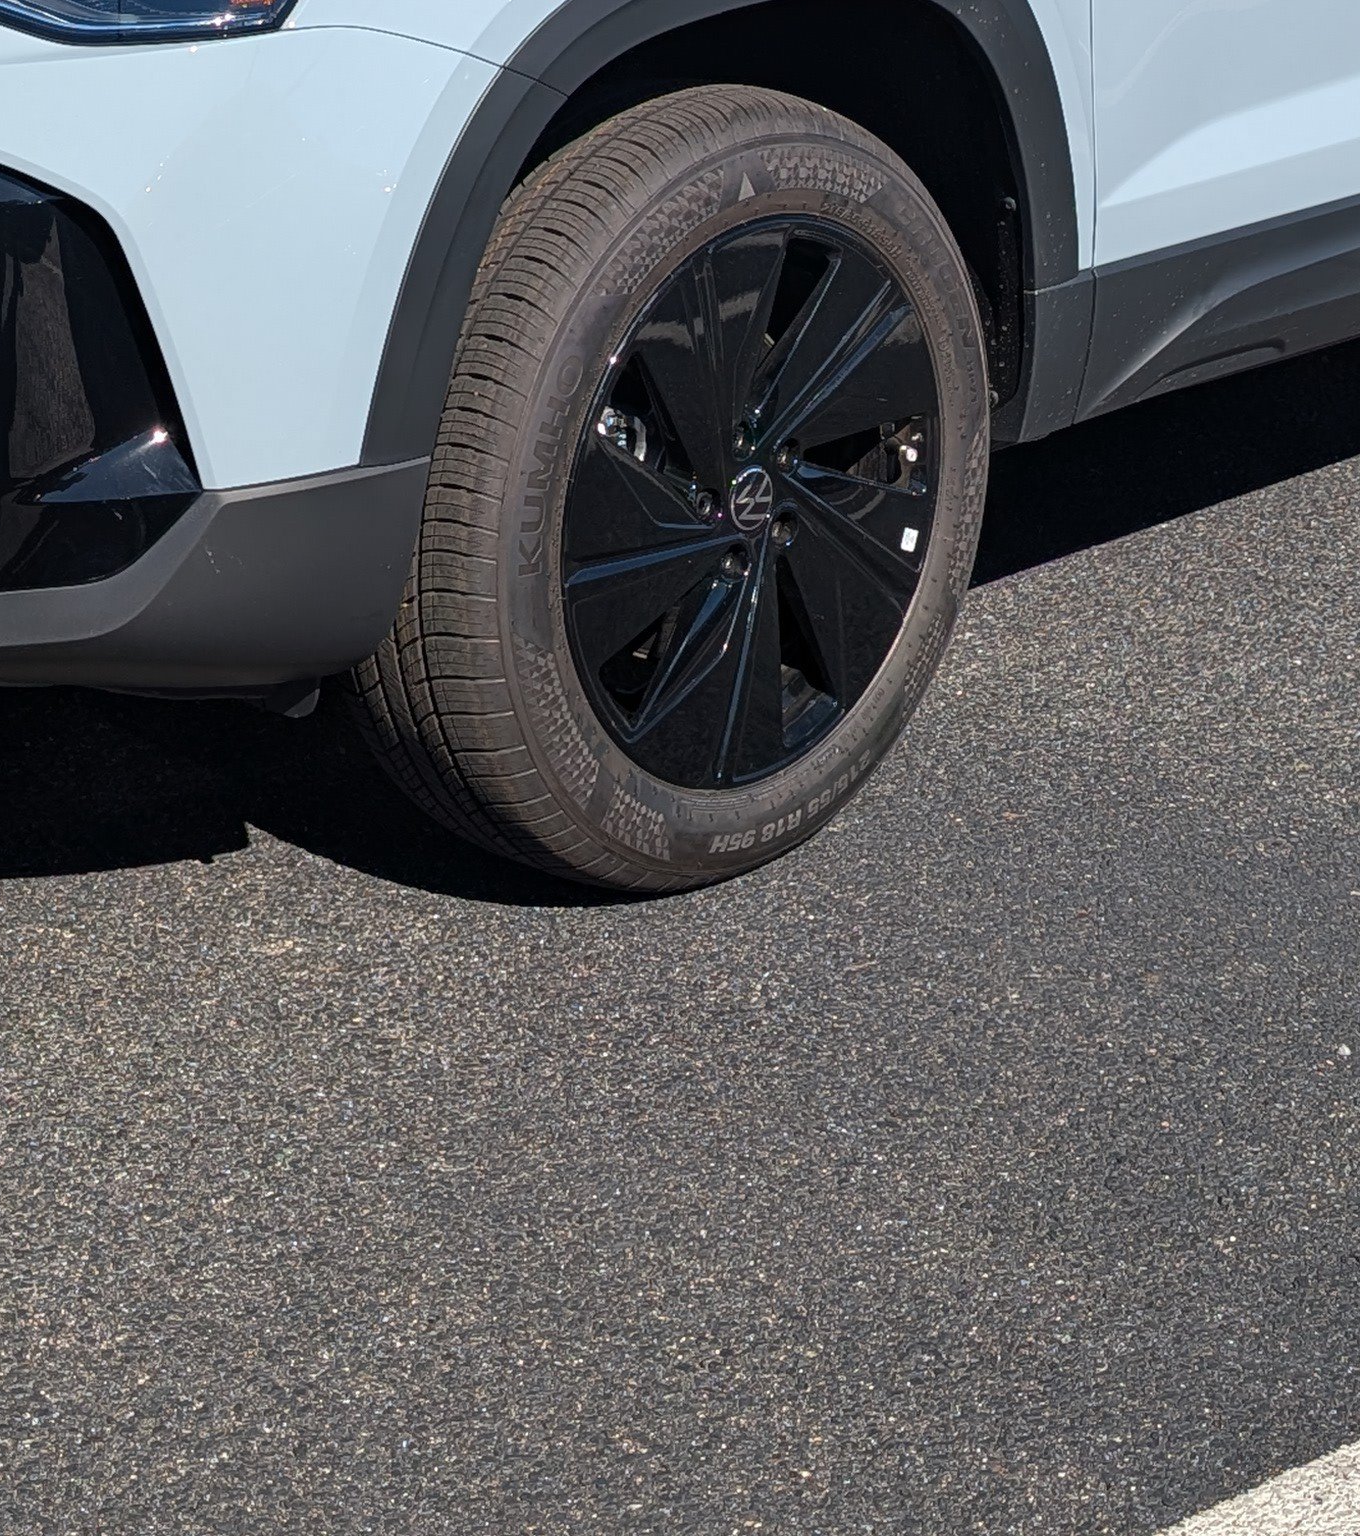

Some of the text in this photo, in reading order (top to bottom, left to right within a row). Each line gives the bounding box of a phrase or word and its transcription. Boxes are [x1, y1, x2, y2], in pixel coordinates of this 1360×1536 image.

[517, 355, 584, 578] KUMHO
[709, 829, 757, 854] 95H
[761, 809, 803, 843] R18
